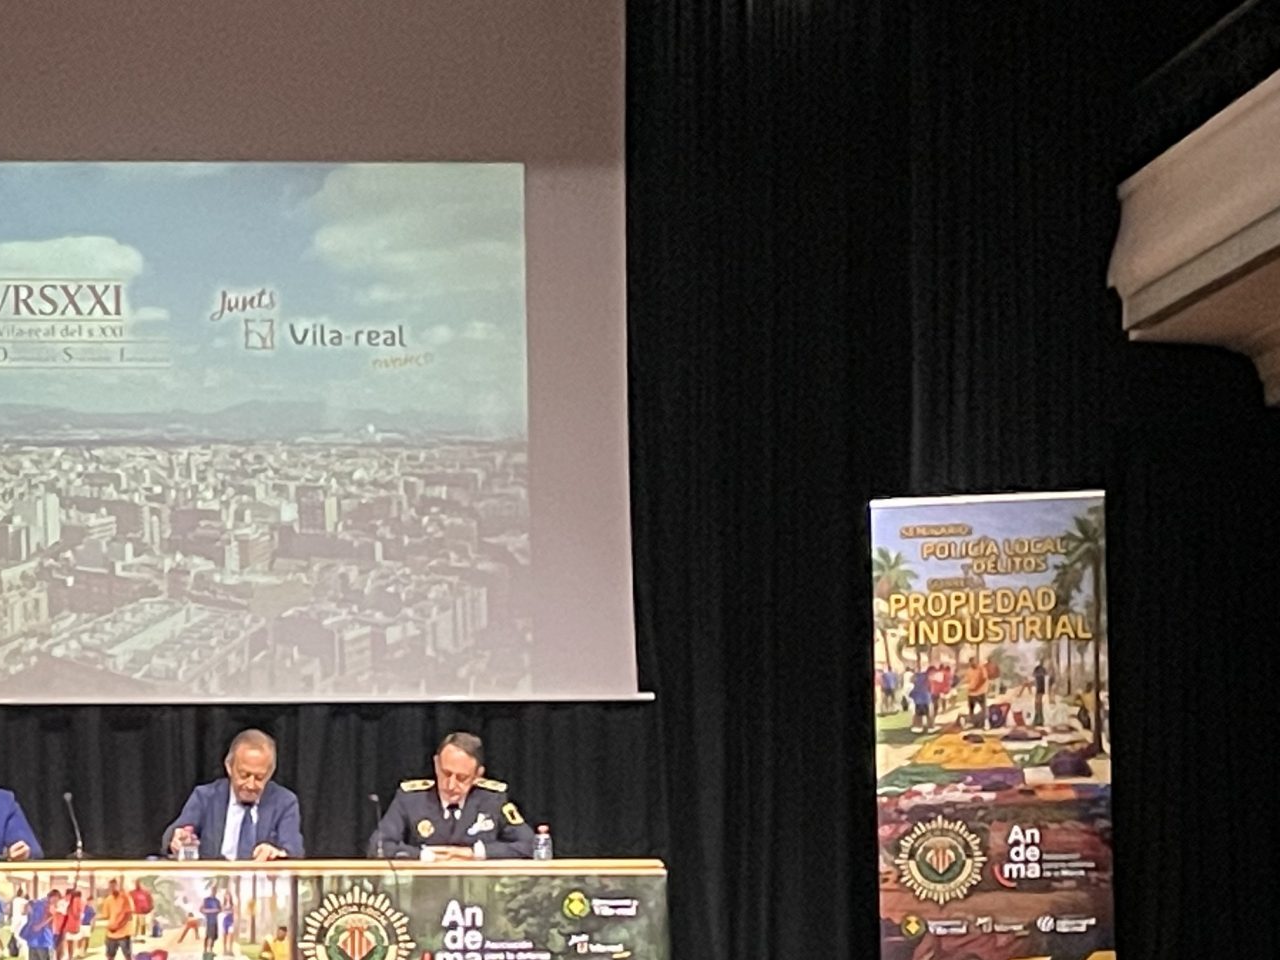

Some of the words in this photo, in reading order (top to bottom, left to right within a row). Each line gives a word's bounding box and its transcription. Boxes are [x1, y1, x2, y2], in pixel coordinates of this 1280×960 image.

[210, 288, 277, 321] Junts
[289, 324, 408, 348] Vila-real
[922, 537, 1000, 561] POLICÍA
[1004, 538, 1068, 557] LOCAL
[972, 556, 1048, 575] DELITOS
[889, 587, 1057, 618] PROPIEDAD
[908, 614, 1094, 646] INDUSTRIAL
[1008, 825, 1040, 844] An
[1010, 844, 1040, 861] de
[1004, 862, 1041, 878] ma
[441, 899, 484, 928] An
[443, 926, 484, 950] de
